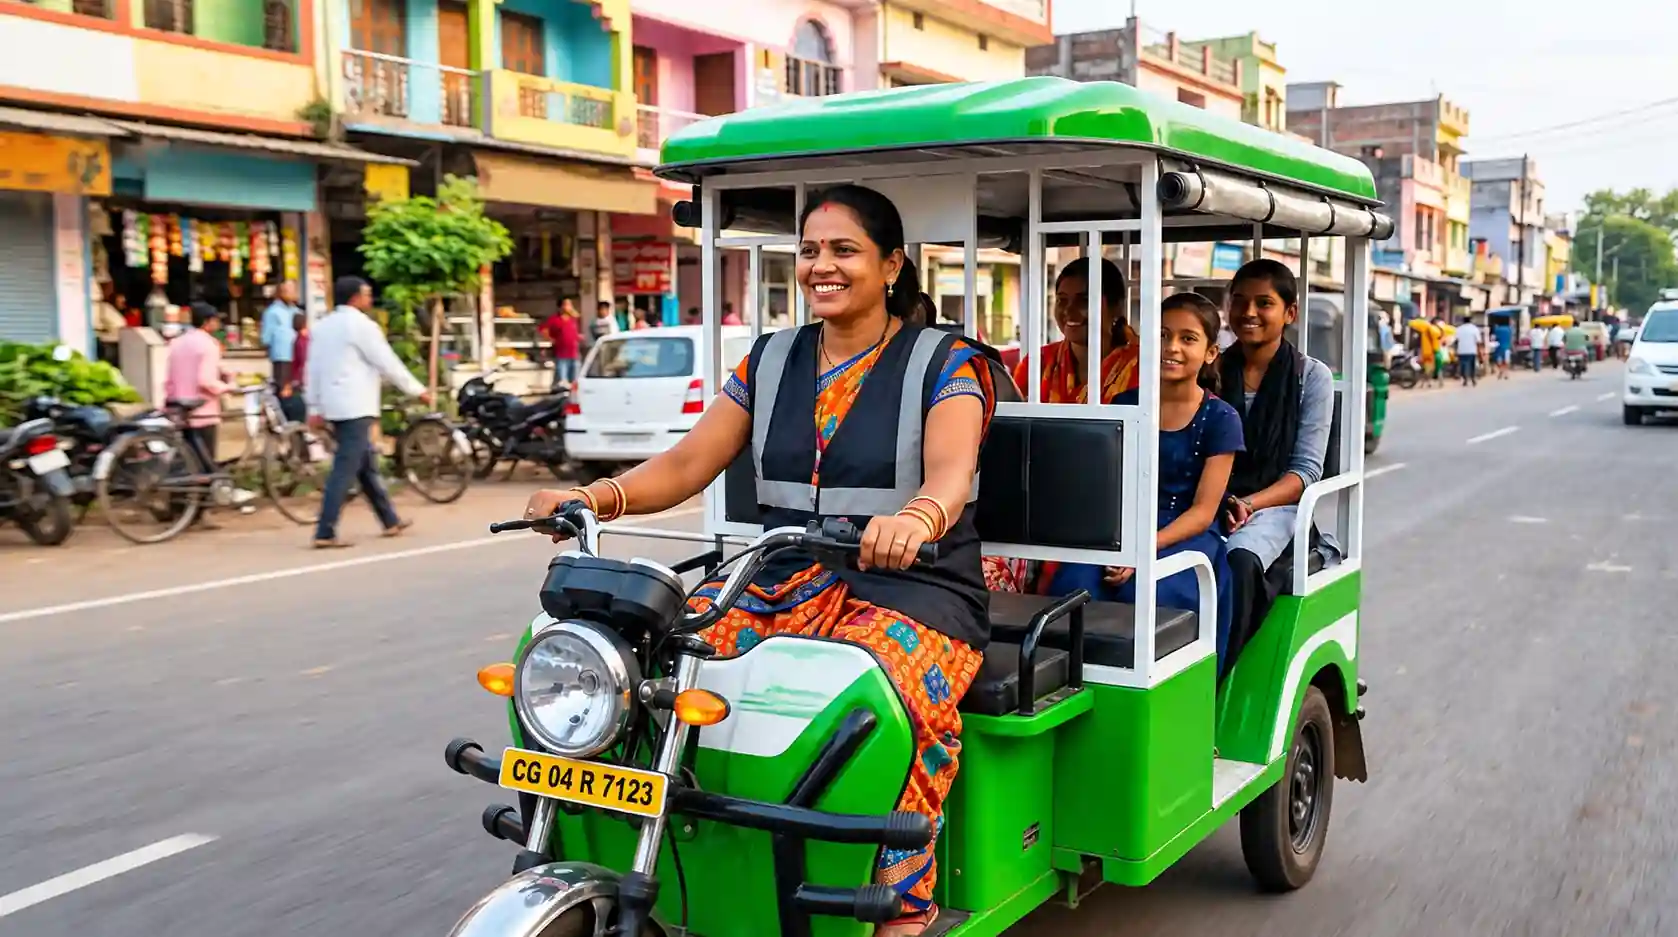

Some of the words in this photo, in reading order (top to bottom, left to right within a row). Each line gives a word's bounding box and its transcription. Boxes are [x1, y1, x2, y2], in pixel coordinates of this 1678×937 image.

[512, 758, 542, 784] CG
[548, 765, 573, 790] 04
[579, 769, 595, 795] R
[602, 774, 653, 806] 7123
